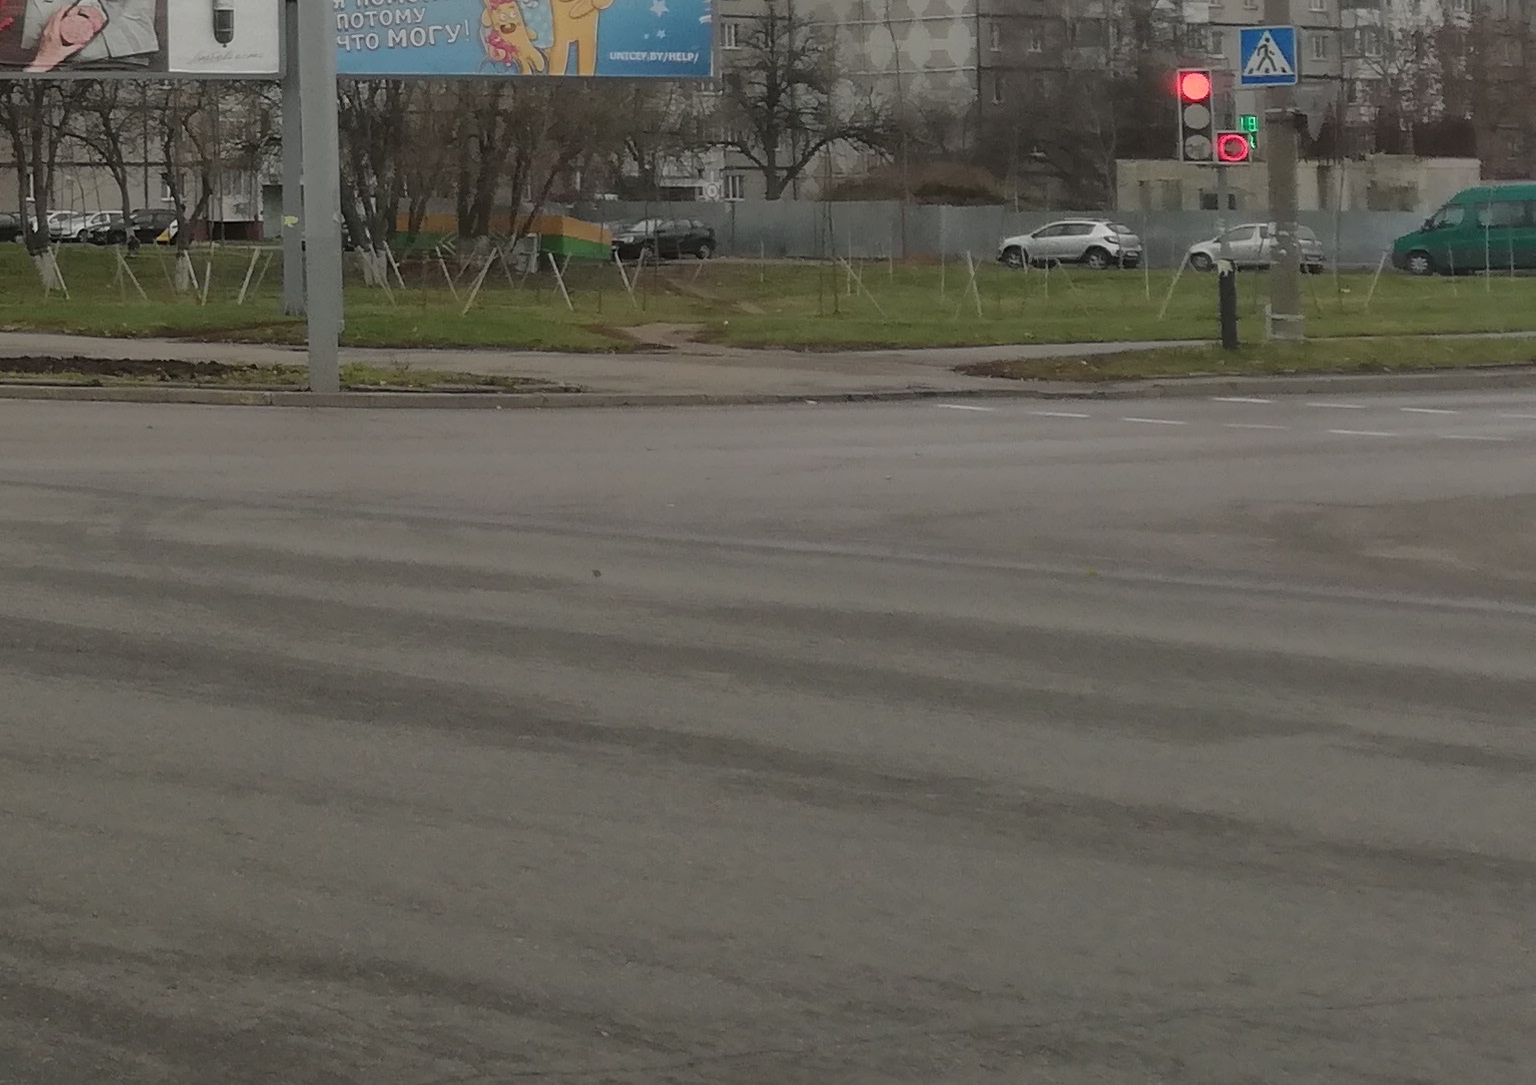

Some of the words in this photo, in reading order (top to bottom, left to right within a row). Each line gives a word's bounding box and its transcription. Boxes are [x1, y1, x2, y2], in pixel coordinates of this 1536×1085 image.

[336, 7, 426, 31] ПОТОМУ
[336, 31, 380, 51] ЧТО
[387, 19, 471, 49] МОГУ!
